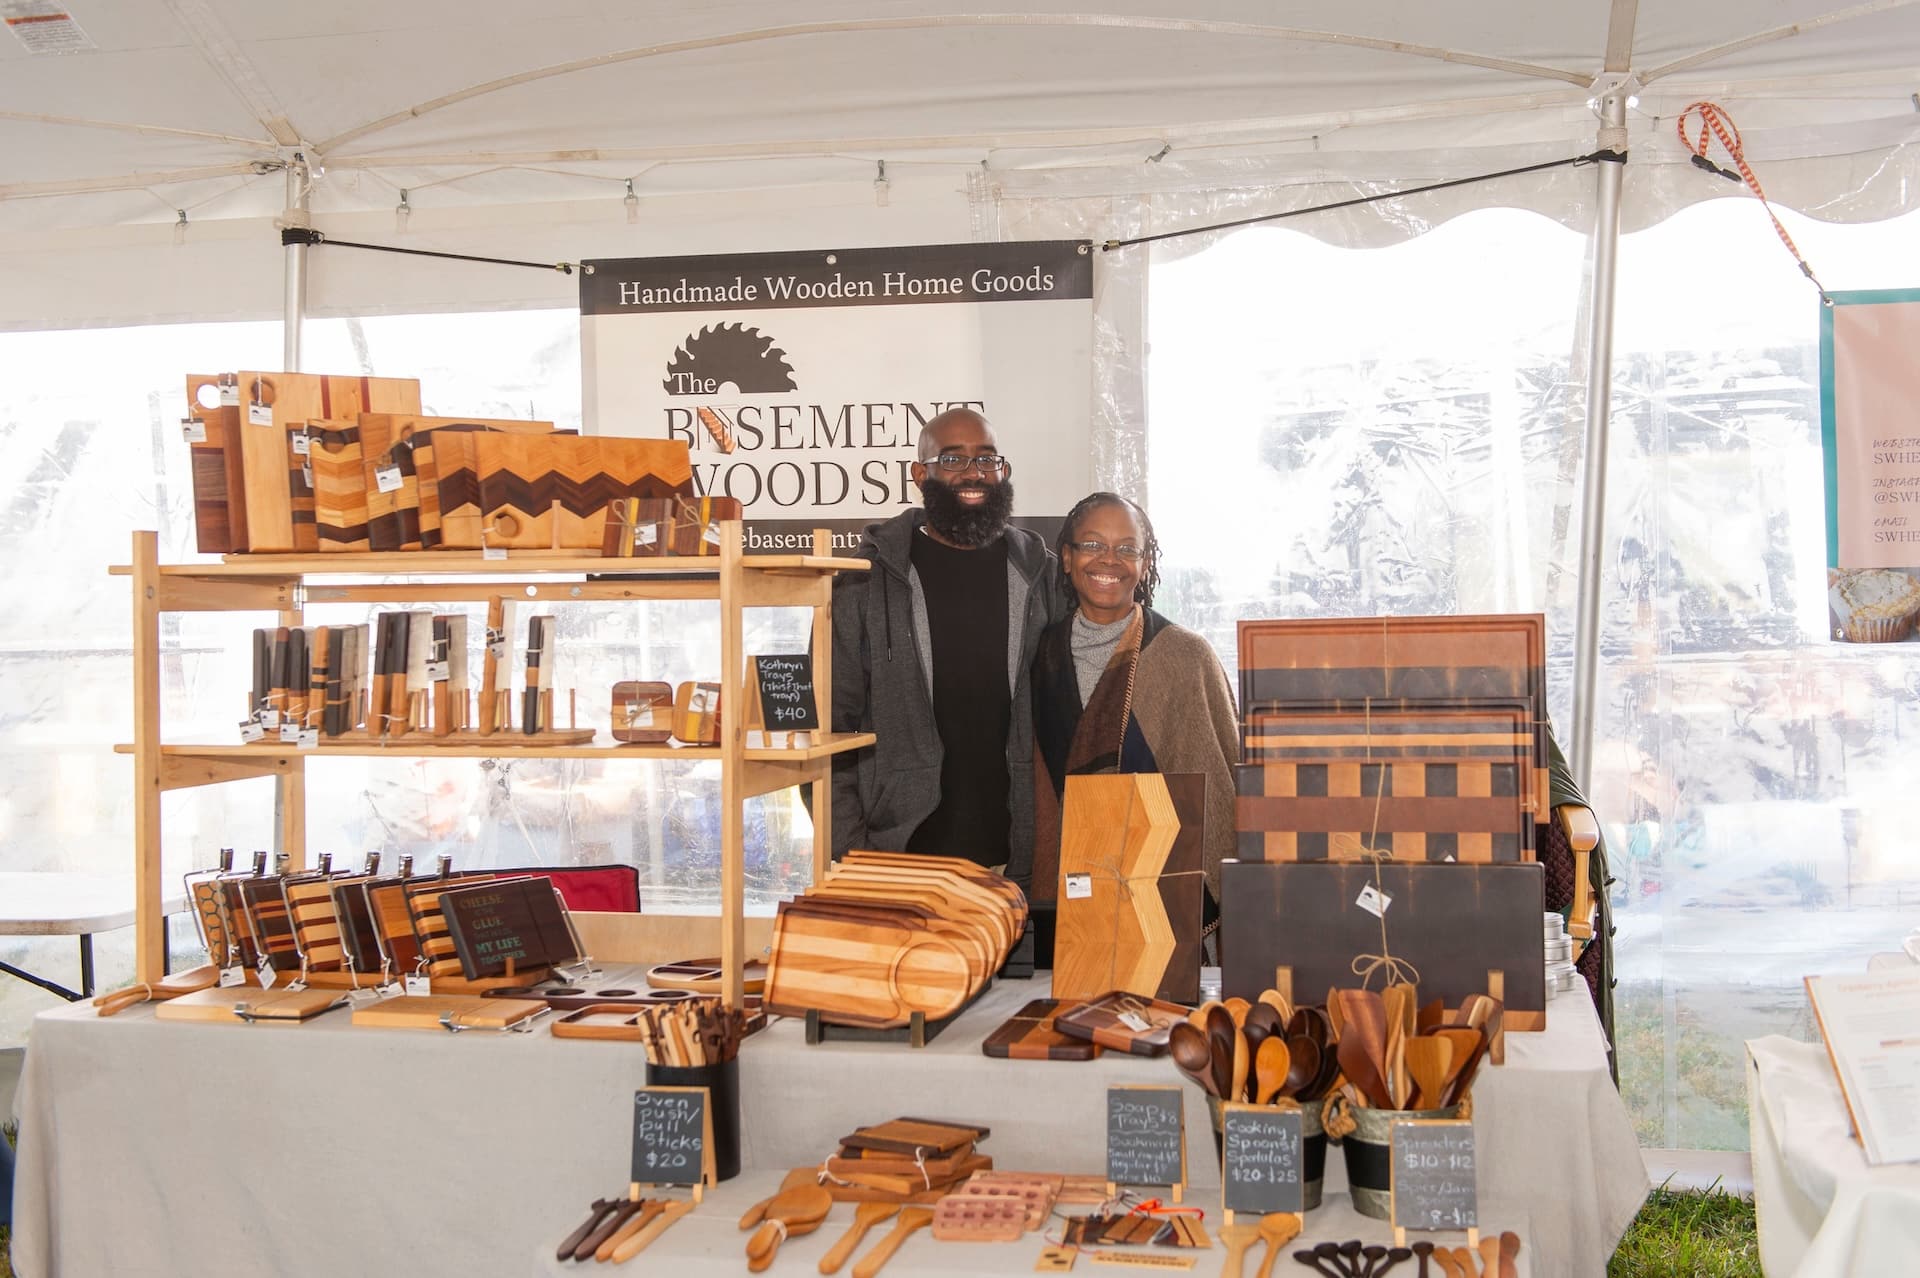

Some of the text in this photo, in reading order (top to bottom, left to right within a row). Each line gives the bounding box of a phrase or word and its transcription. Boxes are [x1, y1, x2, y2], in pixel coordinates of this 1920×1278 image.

[619, 265, 1055, 306] Handmade Wooden Home Goods
[671, 371, 717, 395] The
[759, 659, 804, 672] Kathryn
[774, 706, 807, 722] $40
[459, 895, 505, 910] CHEESE
[472, 917, 504, 930] GLUE
[475, 936, 524, 954] MY LIFE
[635, 1092, 689, 1110] Oven
[1111, 1097, 1159, 1123] Soap
[1226, 1118, 1287, 1140] Cooking
[646, 1149, 687, 1168] $20
[1226, 1149, 1292, 1169] Spatulas
